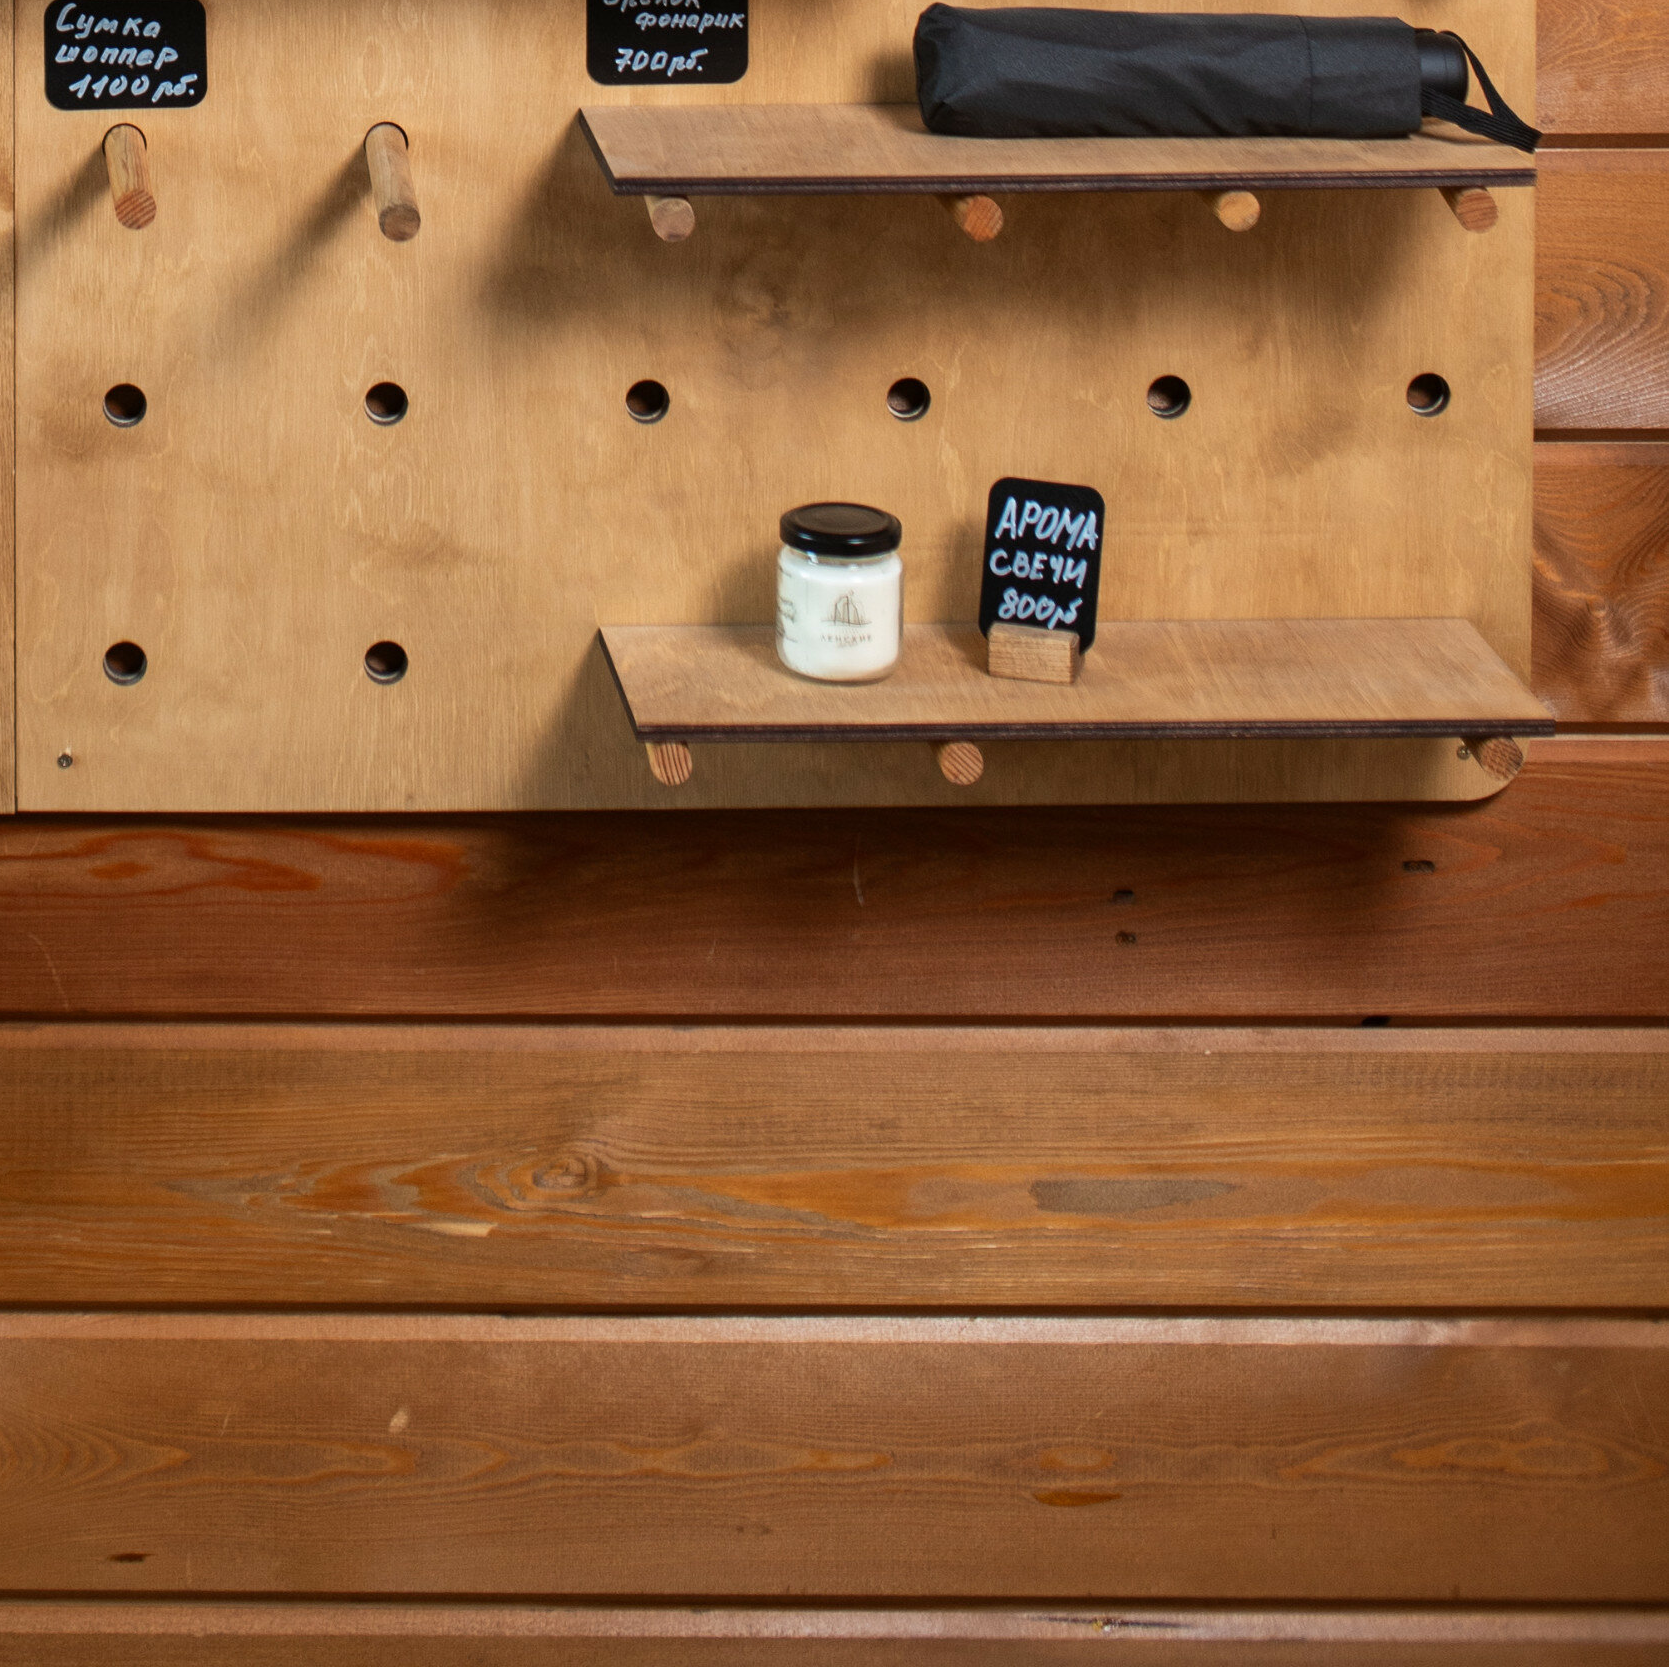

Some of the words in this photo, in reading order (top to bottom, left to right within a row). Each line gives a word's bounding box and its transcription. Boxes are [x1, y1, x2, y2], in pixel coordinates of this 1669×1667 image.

[56, 3, 161, 39] Сумка
[635, 12, 745, 34] фонарик
[55, 44, 179, 70] шоппер
[994, 496, 1099, 551] АРОМА
[989, 548, 1087, 589] СВЕЧИ
